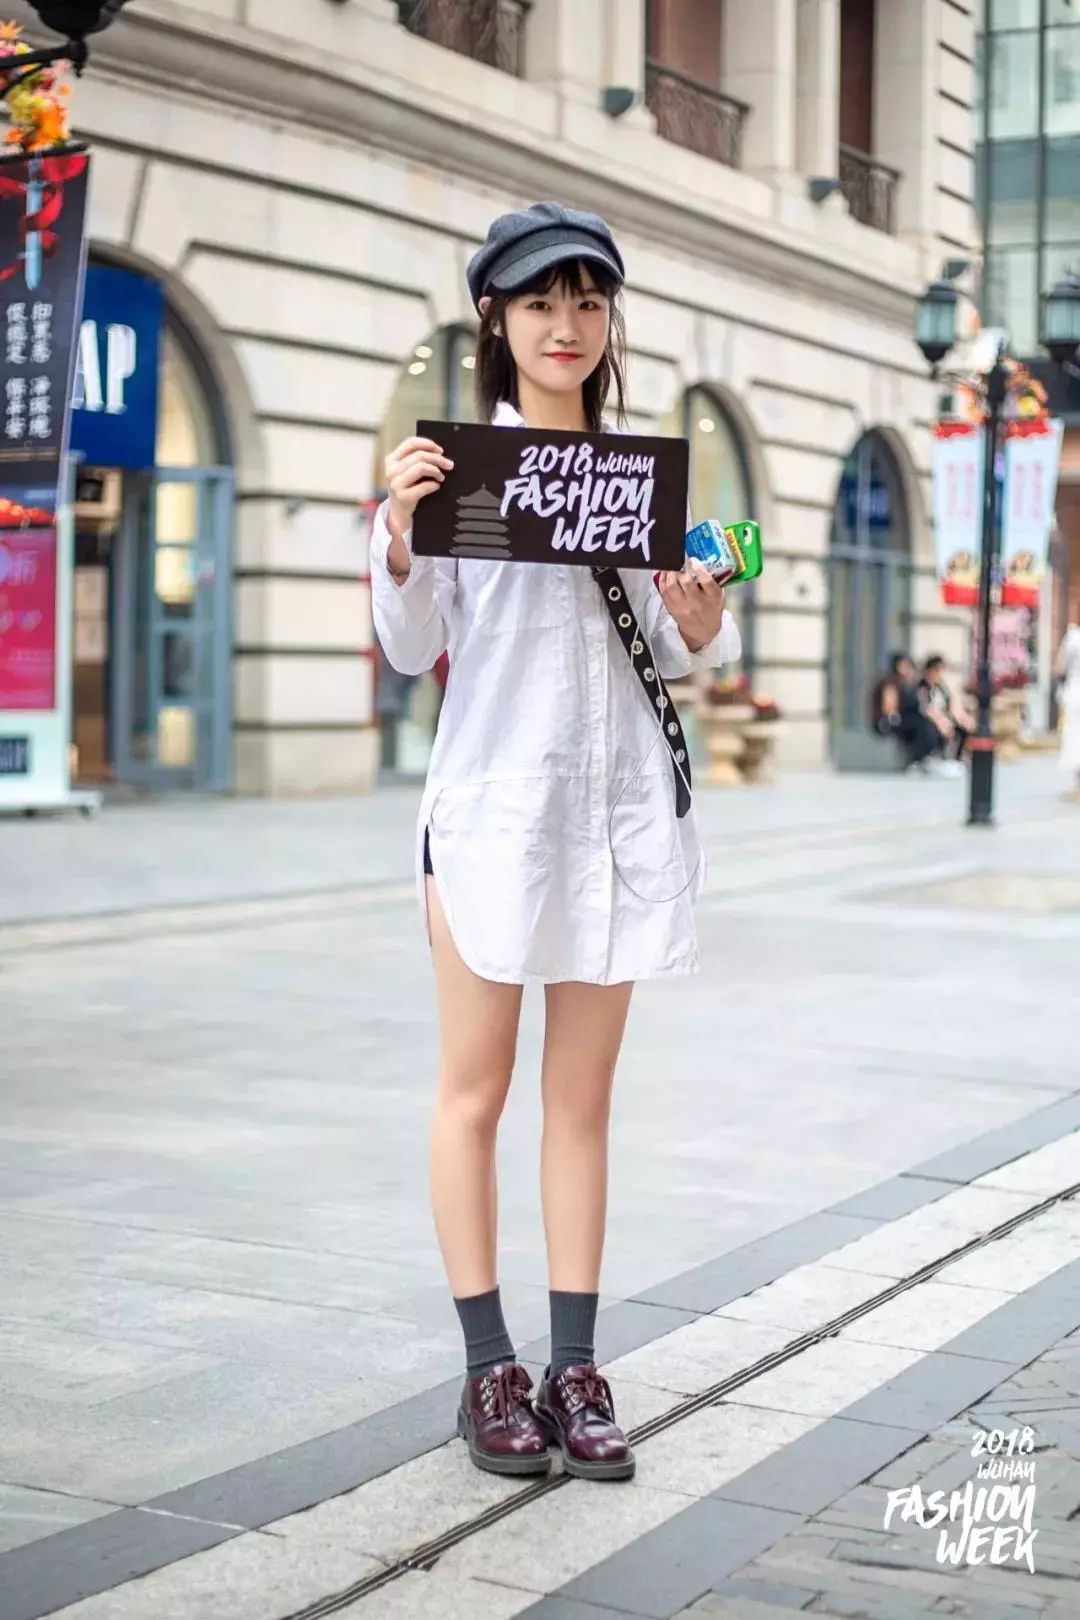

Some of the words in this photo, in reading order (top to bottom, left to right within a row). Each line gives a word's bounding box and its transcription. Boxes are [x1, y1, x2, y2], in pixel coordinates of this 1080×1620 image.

[70, 319, 136, 415] AP
[519, 442, 592, 476] 2018
[595, 451, 655, 478] WUHAN
[500, 473, 655, 523] FASHION
[551, 516, 656, 562] WEEK
